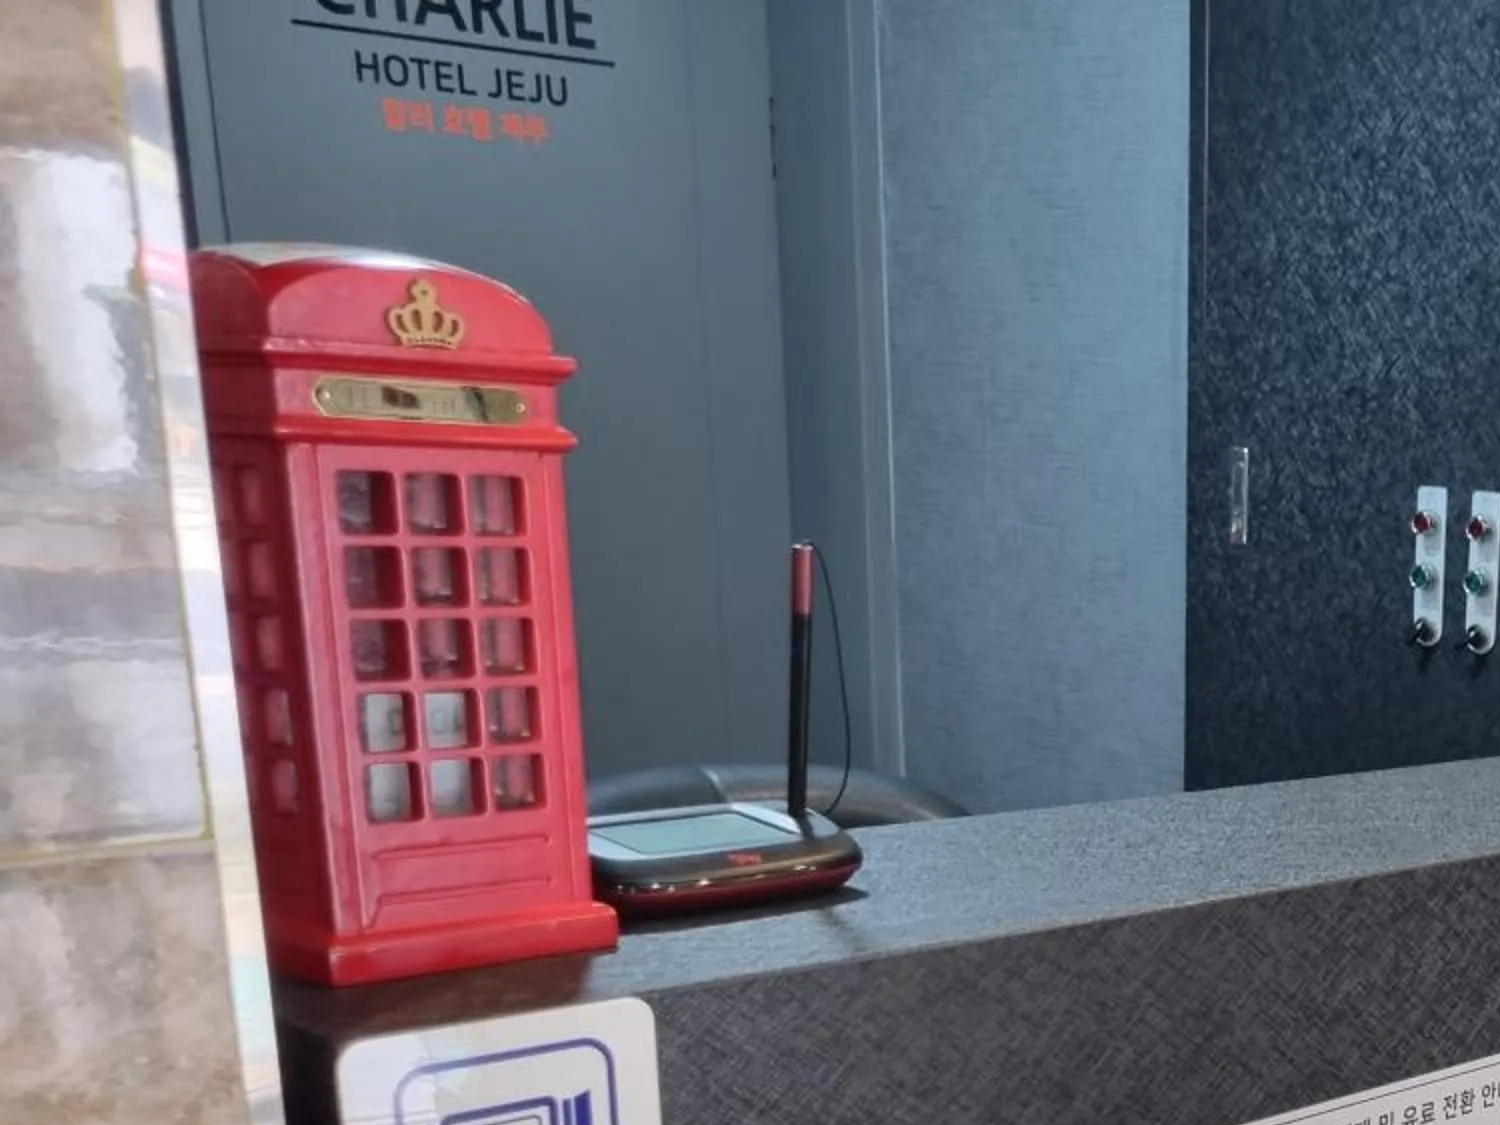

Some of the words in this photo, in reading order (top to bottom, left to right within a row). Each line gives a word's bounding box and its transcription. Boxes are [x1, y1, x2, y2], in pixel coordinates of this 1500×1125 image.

[317, 0, 597, 50] RLIE
[354, 50, 477, 97] HOTEL
[487, 67, 567, 107] JEJU
[1442, 1087, 1476, 1121] 전환
